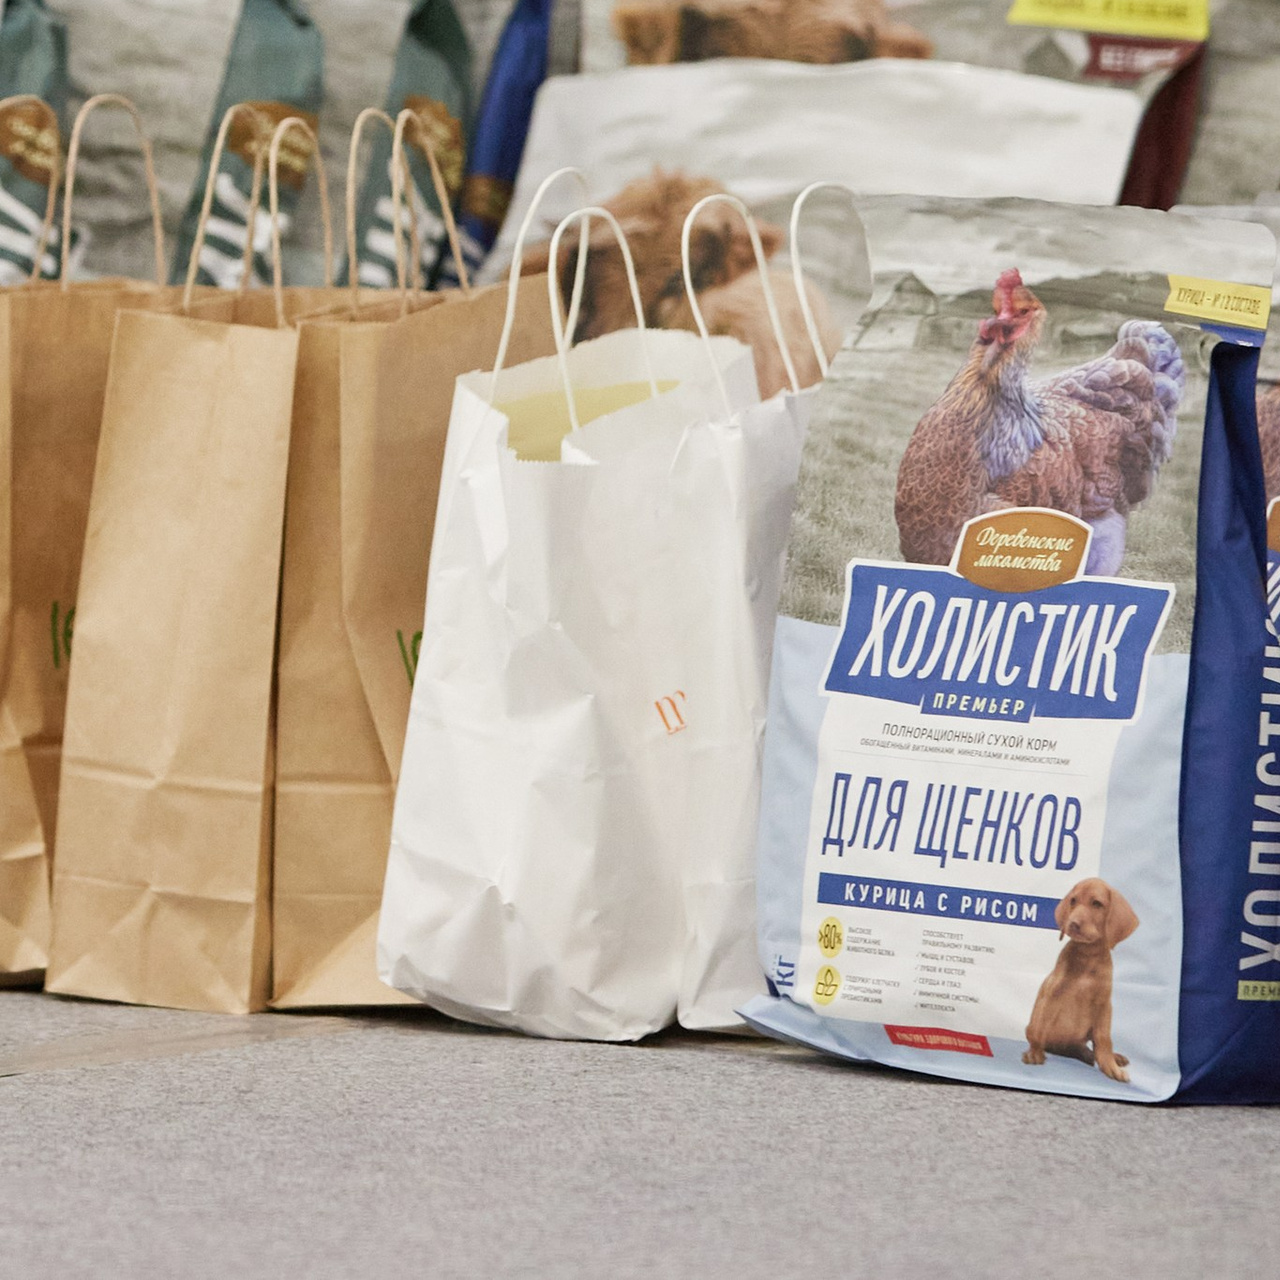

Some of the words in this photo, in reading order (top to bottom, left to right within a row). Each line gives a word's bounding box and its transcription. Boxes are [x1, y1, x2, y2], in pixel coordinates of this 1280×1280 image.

[976, 526, 1074, 554] Деревенские
[973, 552, 1062, 572] лакомства
[848, 584, 1137, 702] ХОЛИСТИК
[932, 694, 1025, 716] ПРЕМЬЕР
[881, 723, 985, 745] ПОЛНОРАЦИОННЫЙ
[986, 732, 1023, 749] СУХОЙ
[1027, 738, 1057, 752] КОРМ
[822, 772, 908, 857] ДЛЯ
[913, 783, 1083, 871] ЩЕНКОВ
[844, 883, 925, 910] КУРИЦА
[937, 893, 949, 912] С
[960, 895, 1038, 922] РИСОМ
